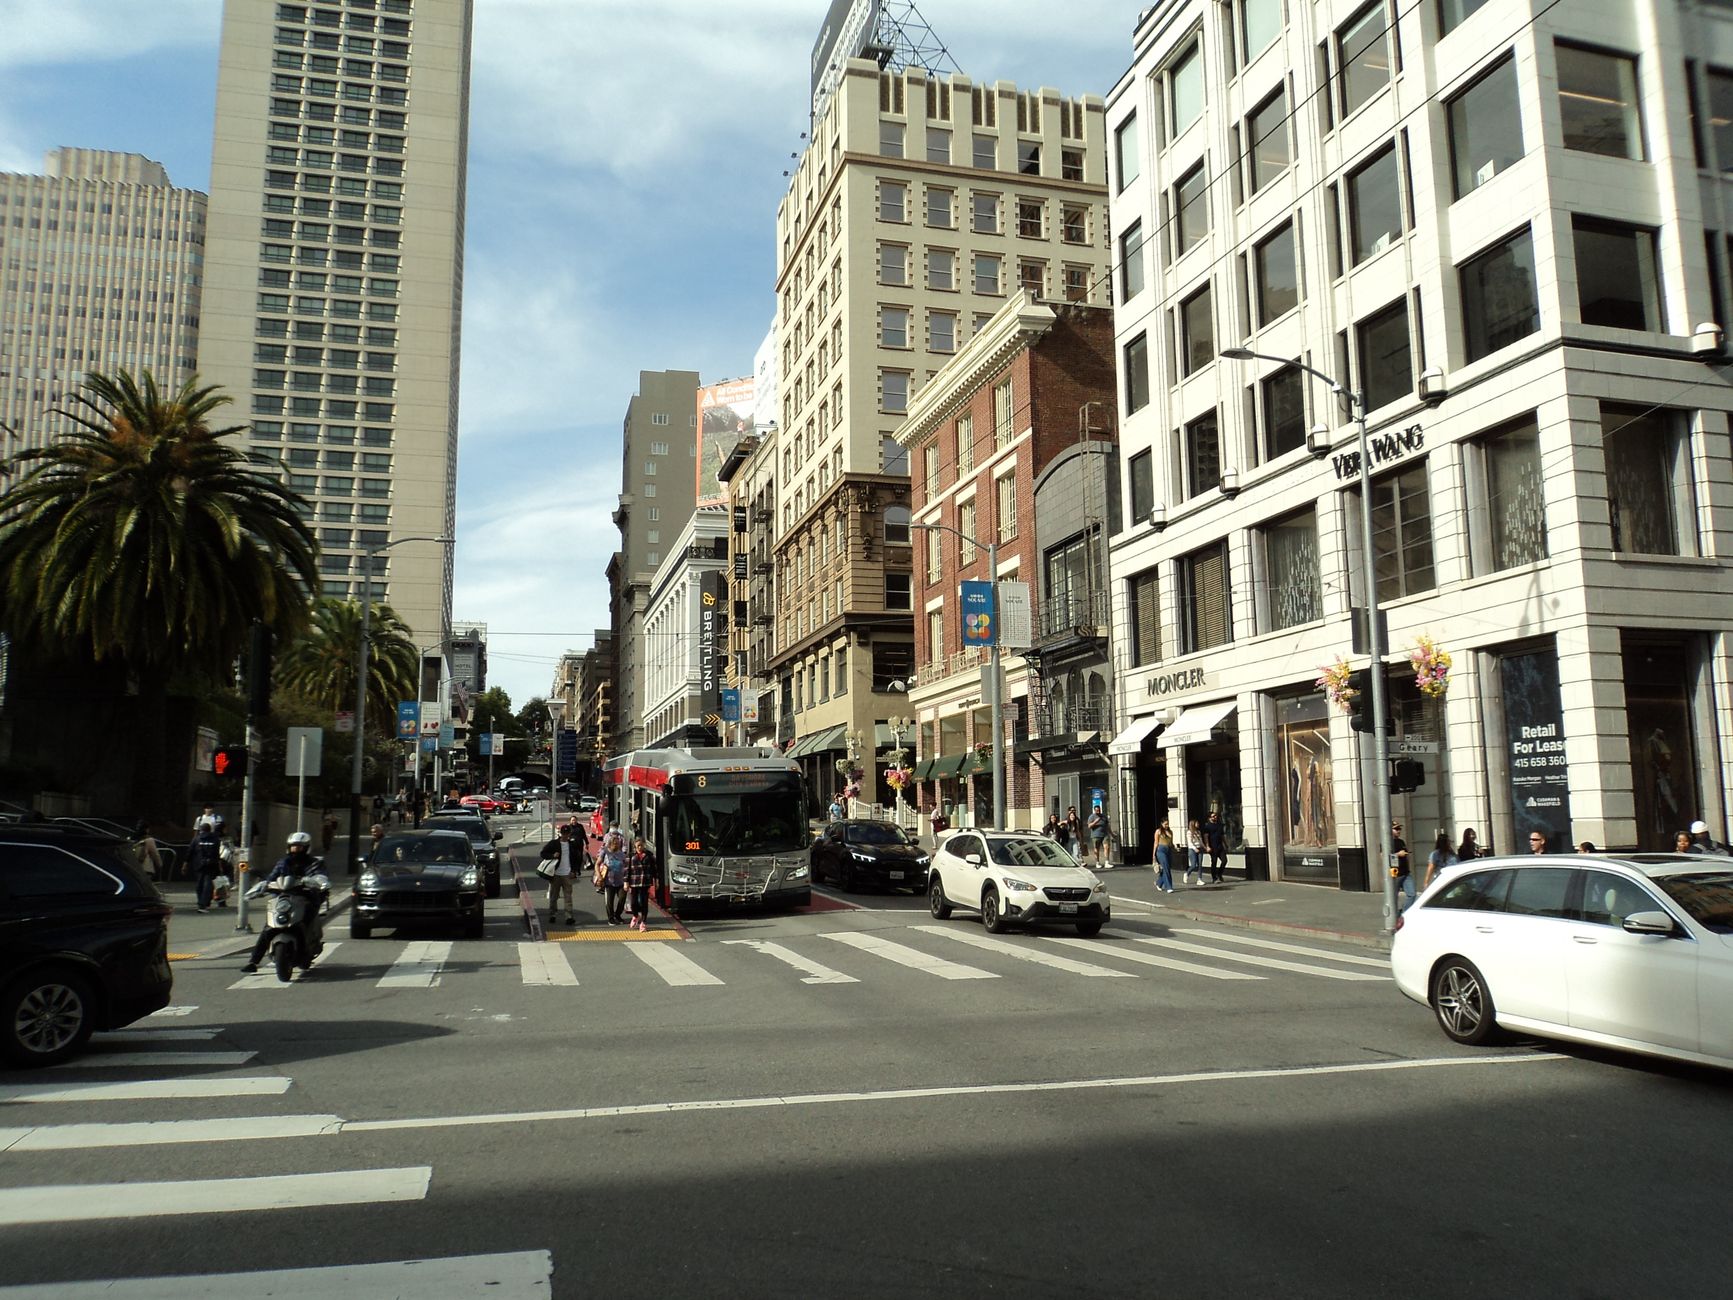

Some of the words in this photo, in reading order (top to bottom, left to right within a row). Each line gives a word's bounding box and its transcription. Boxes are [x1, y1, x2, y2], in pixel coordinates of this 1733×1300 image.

[1371, 424, 1424, 461] WANG
[703, 610, 713, 692] BREITLING
[1147, 667, 1206, 697] MONCLER
[1522, 724, 1556, 738] Retail
[1400, 743, 1428, 752] Geary
[1513, 741, 1534, 754] For
[1514, 758, 1529, 768] 415
[1530, 757, 1547, 768] 658
[698, 775, 706, 788] 8
[685, 841, 700, 851] 301
